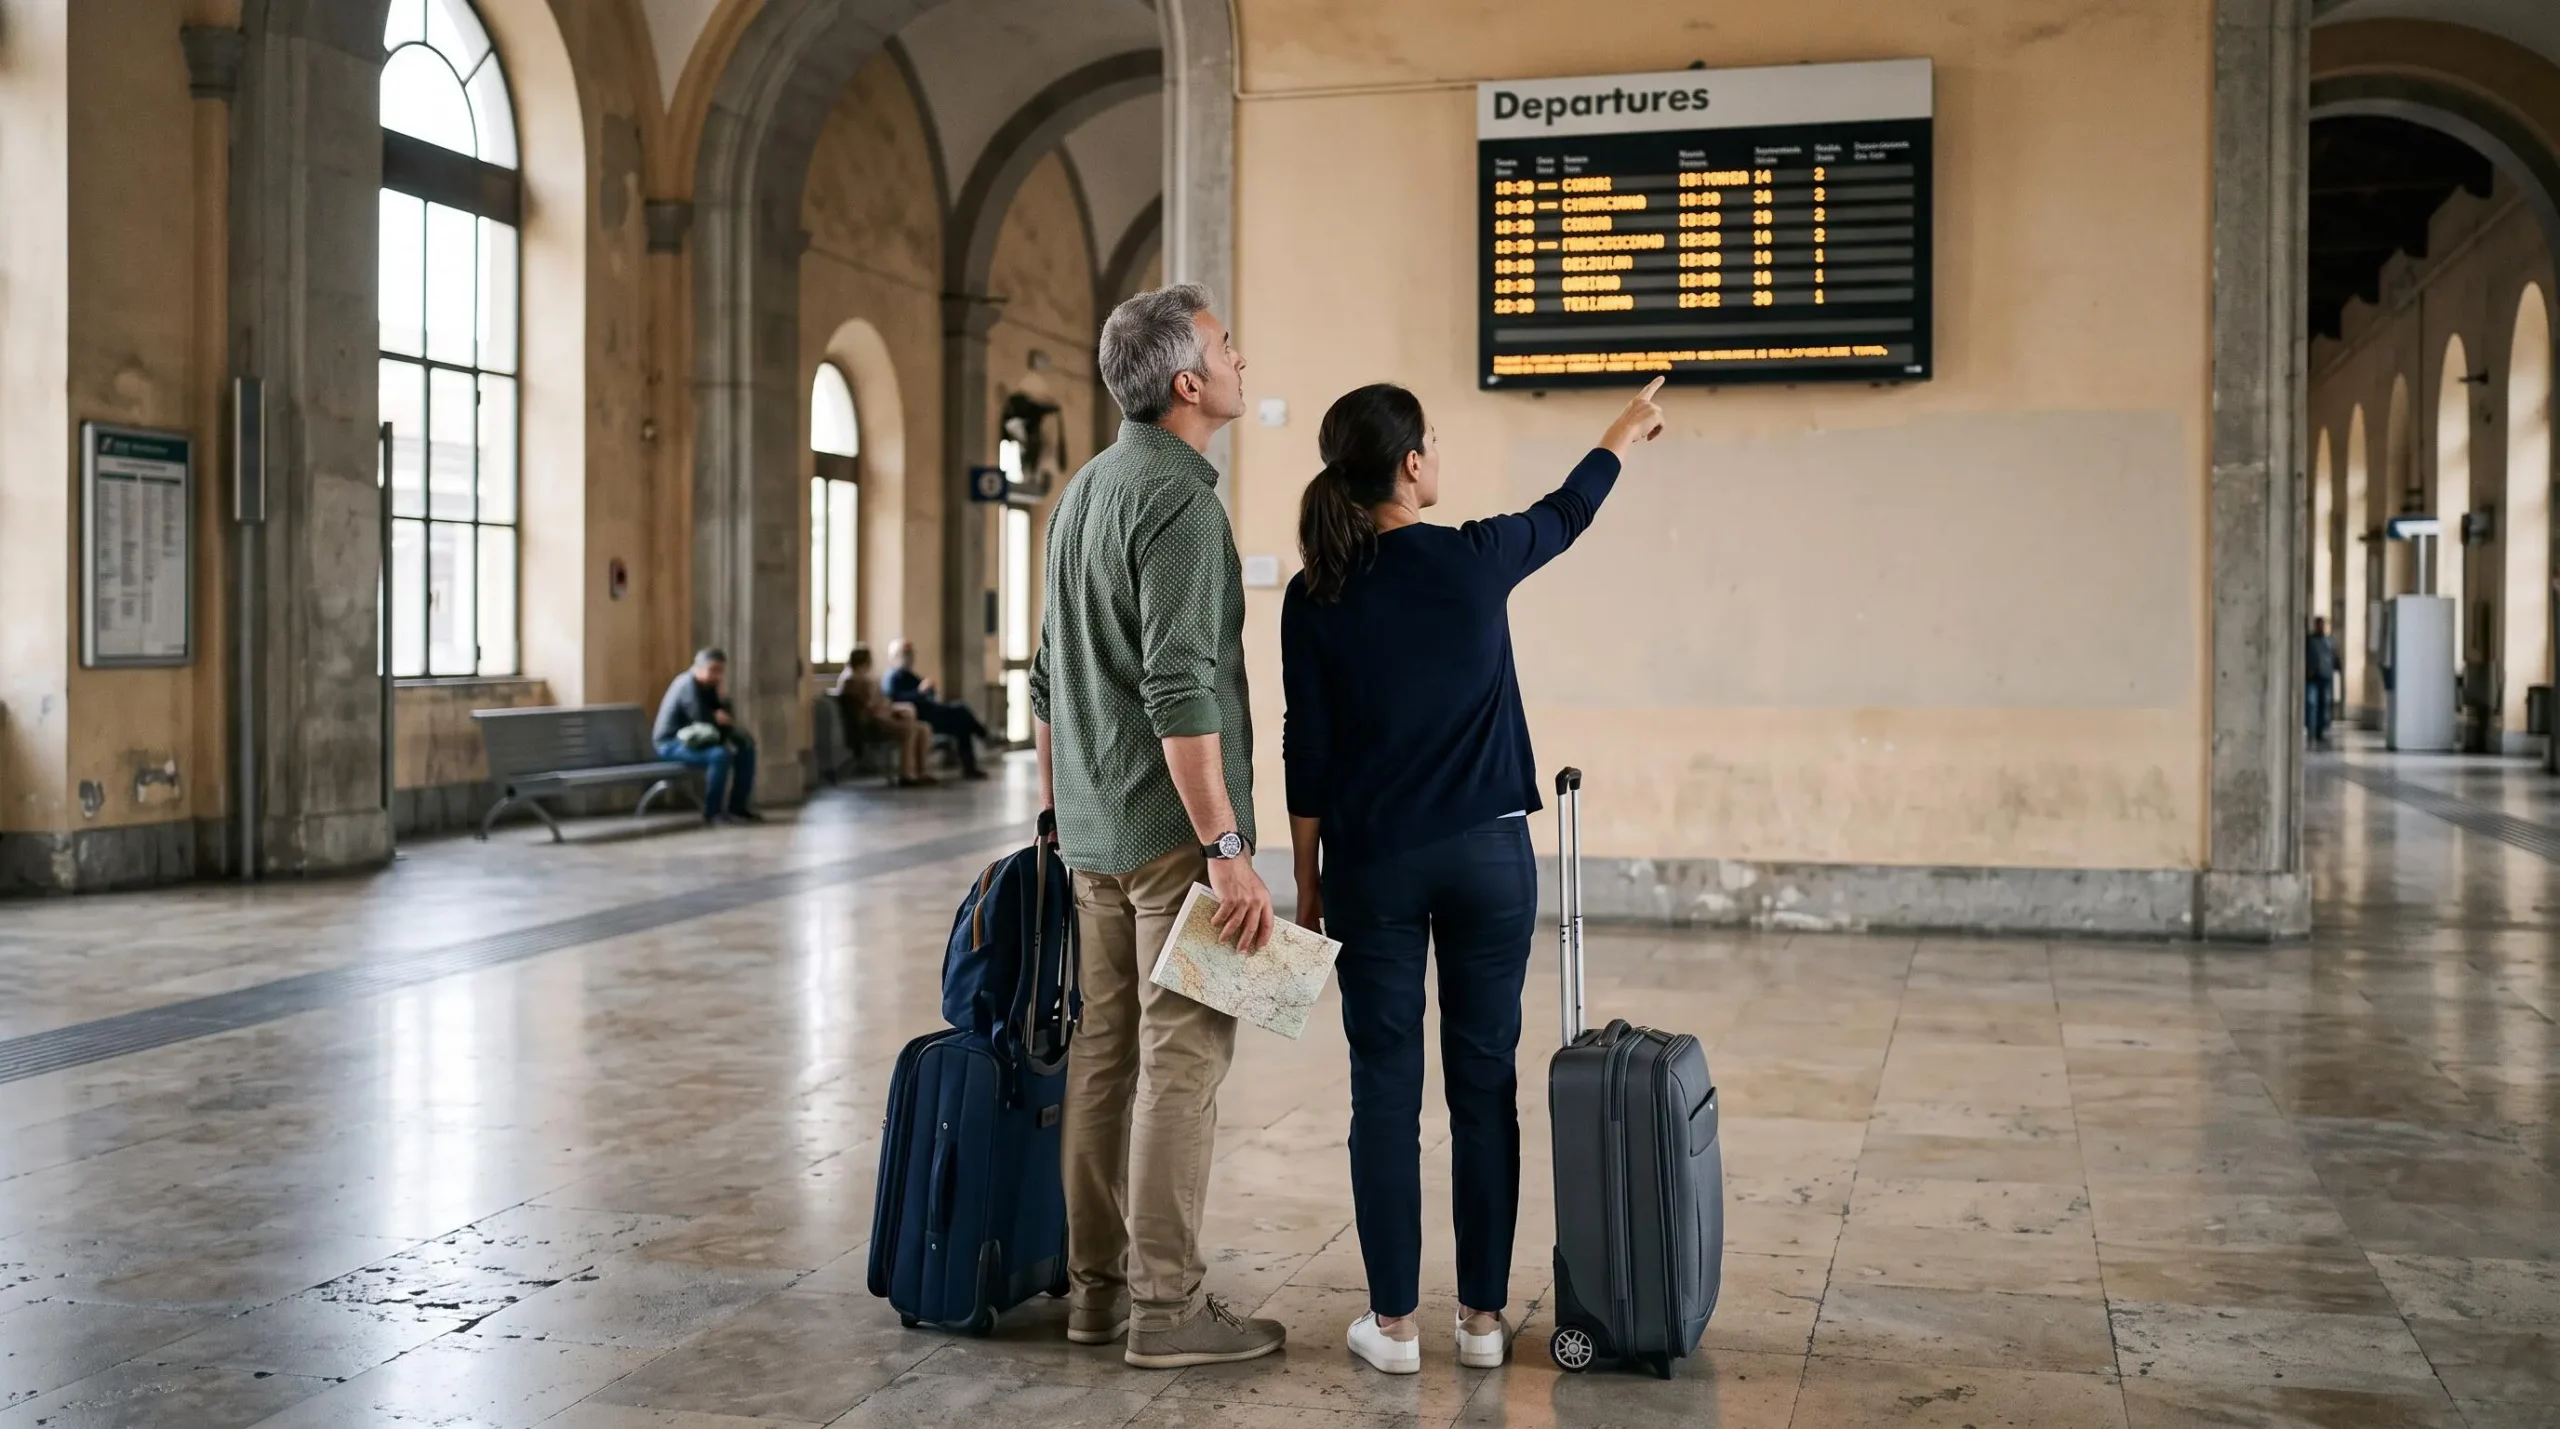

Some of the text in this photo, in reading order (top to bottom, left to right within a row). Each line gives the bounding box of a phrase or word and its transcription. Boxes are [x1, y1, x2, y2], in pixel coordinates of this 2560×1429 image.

[1494, 87, 1710, 126] Departures
[1815, 168, 1825, 182] 2
[1815, 188, 1825, 201] 2
[1814, 208, 1825, 221] 2
[1814, 228, 1825, 242] 2
[1815, 249, 1824, 262] 1
[1815, 269, 1824, 282] 1
[1815, 289, 1824, 303] 1
